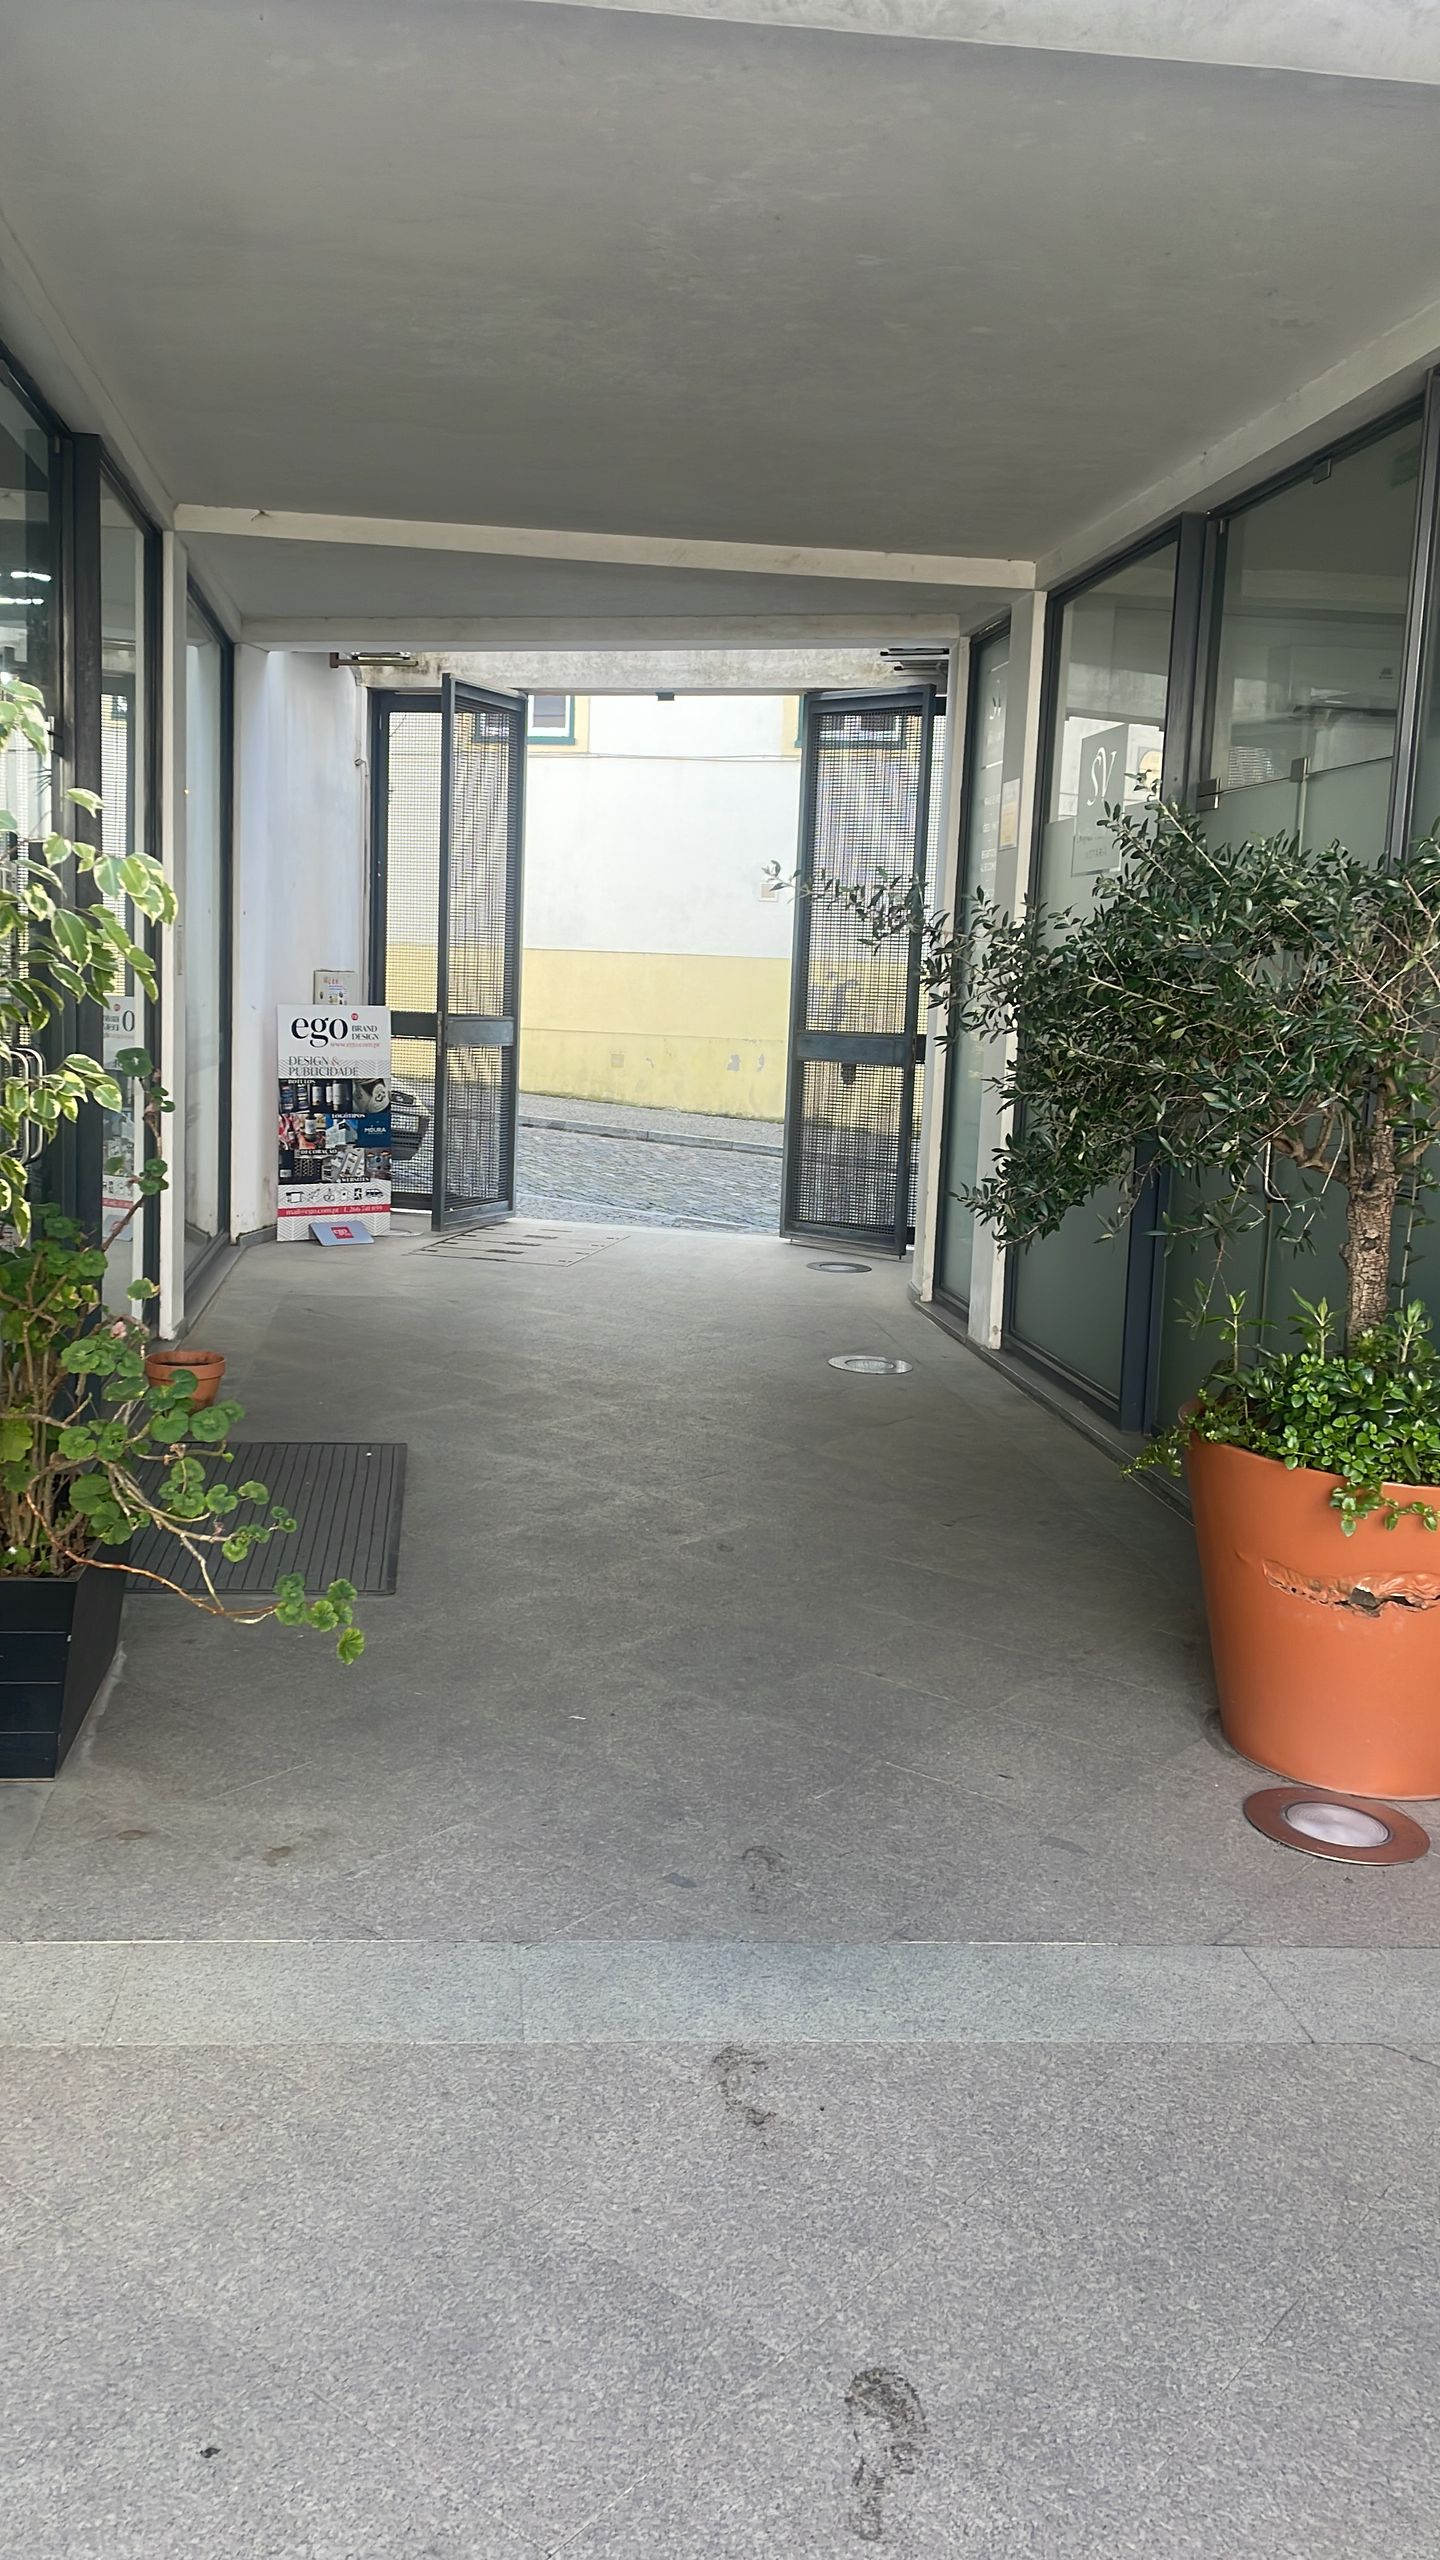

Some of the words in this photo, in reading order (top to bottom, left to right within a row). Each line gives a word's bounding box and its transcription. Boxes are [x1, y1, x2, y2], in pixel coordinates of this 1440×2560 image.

[291, 1017, 348, 1048] ego
[351, 1025, 378, 1033] BRAND
[351, 1033, 380, 1041] DESIGN
[288, 1056, 330, 1066] DESIGN
[331, 1056, 340, 1066] &
[288, 1067, 360, 1077] PUBLICIDADE
